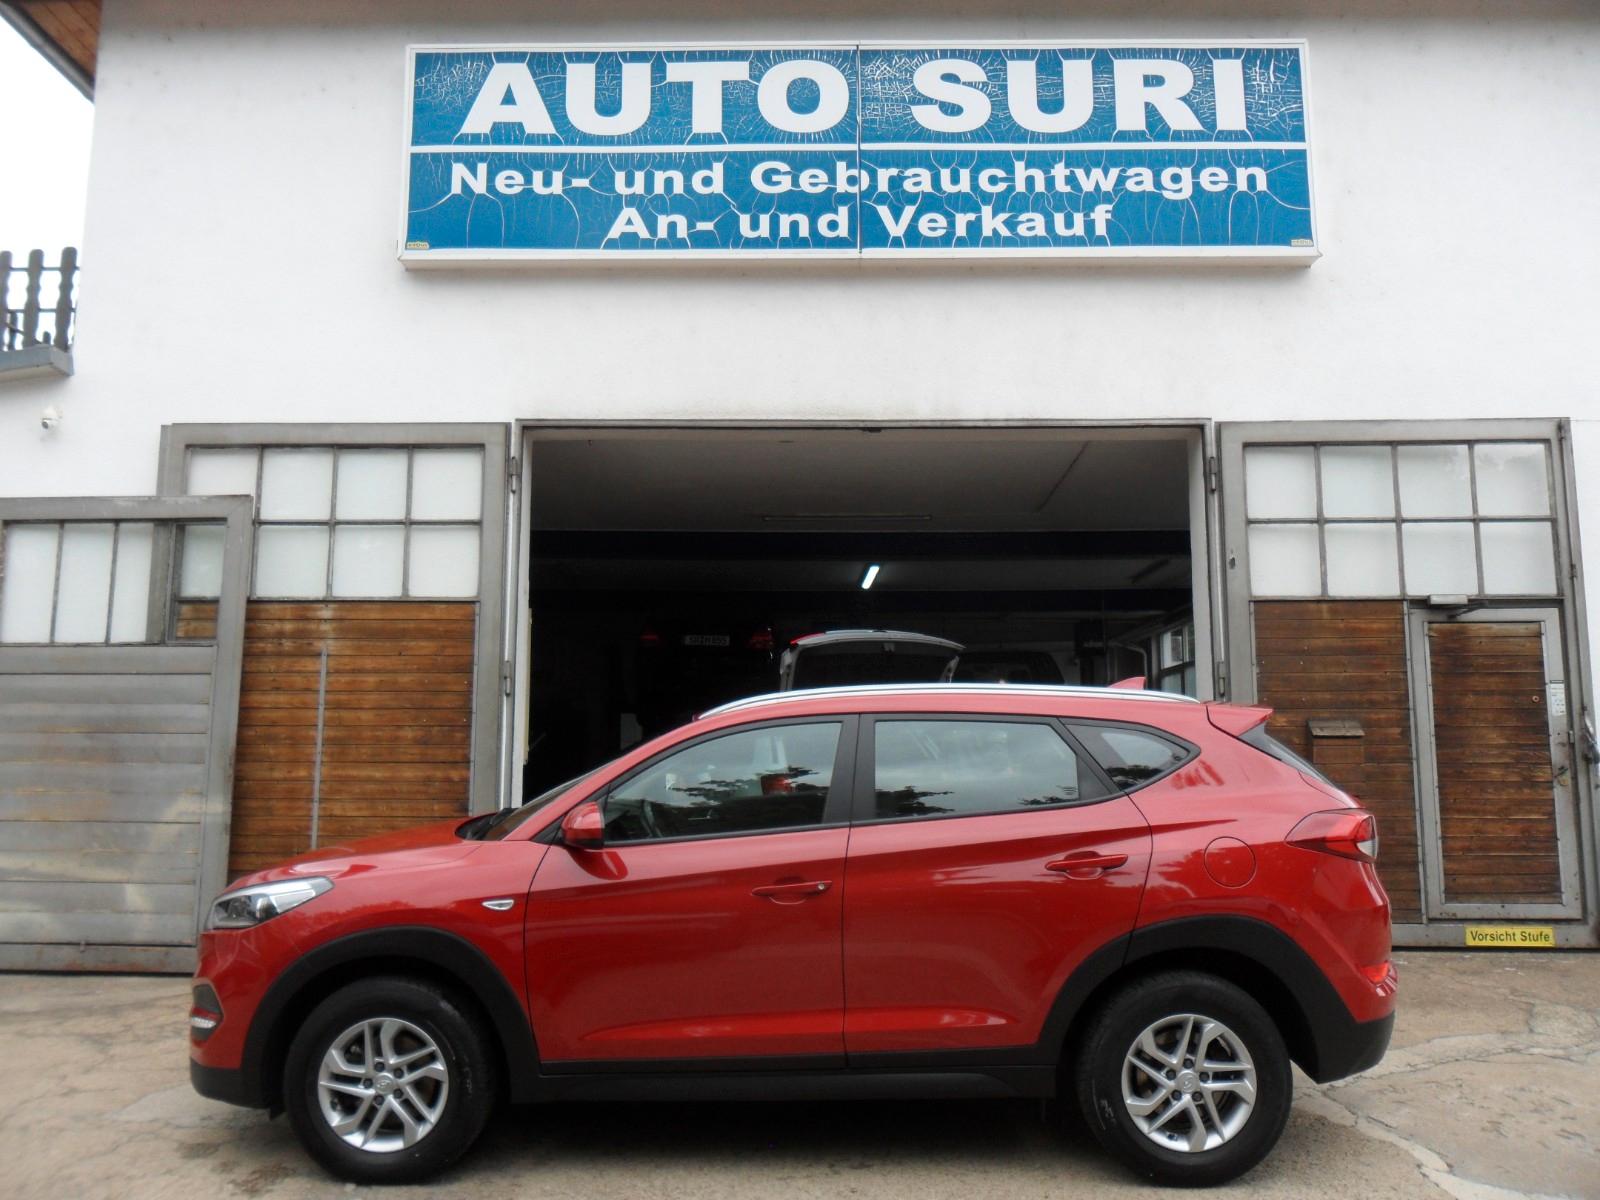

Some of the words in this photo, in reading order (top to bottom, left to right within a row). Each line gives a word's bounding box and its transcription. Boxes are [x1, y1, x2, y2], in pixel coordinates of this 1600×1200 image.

[460, 59, 850, 136] AUTO
[909, 58, 1248, 133] SURI
[451, 162, 590, 195] Neu-
[614, 161, 724, 195] und
[750, 160, 1268, 200] Gebrauchtwagen
[607, 207, 714, 239] An-
[739, 206, 849, 238] und
[876, 203, 1112, 237] Verkauf
[1470, 931, 1516, 942] Vorsicht
[1520, 931, 1550, 942] Stufe
